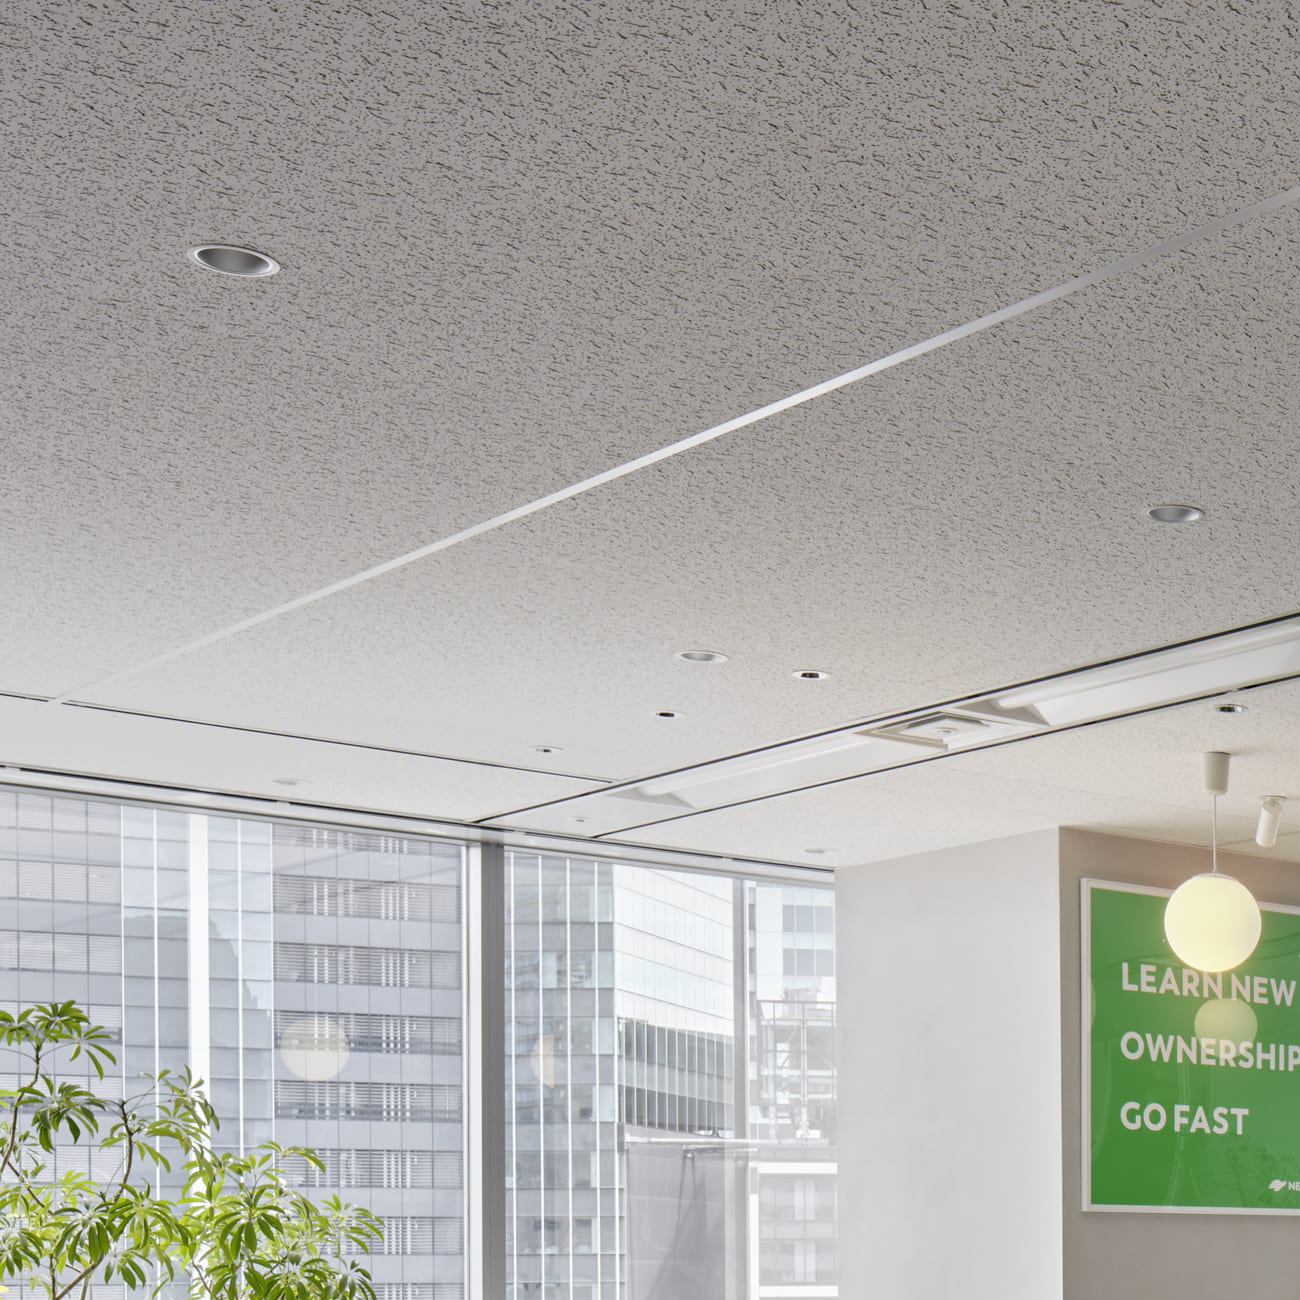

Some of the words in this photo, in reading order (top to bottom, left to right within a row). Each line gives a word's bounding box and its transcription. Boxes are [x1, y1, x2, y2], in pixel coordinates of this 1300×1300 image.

[1122, 962, 1223, 1000] LEARN
[1231, 973, 1297, 1007] NEW
[1120, 1101, 1167, 1131] GO
[1174, 1104, 1249, 1135] FAST
